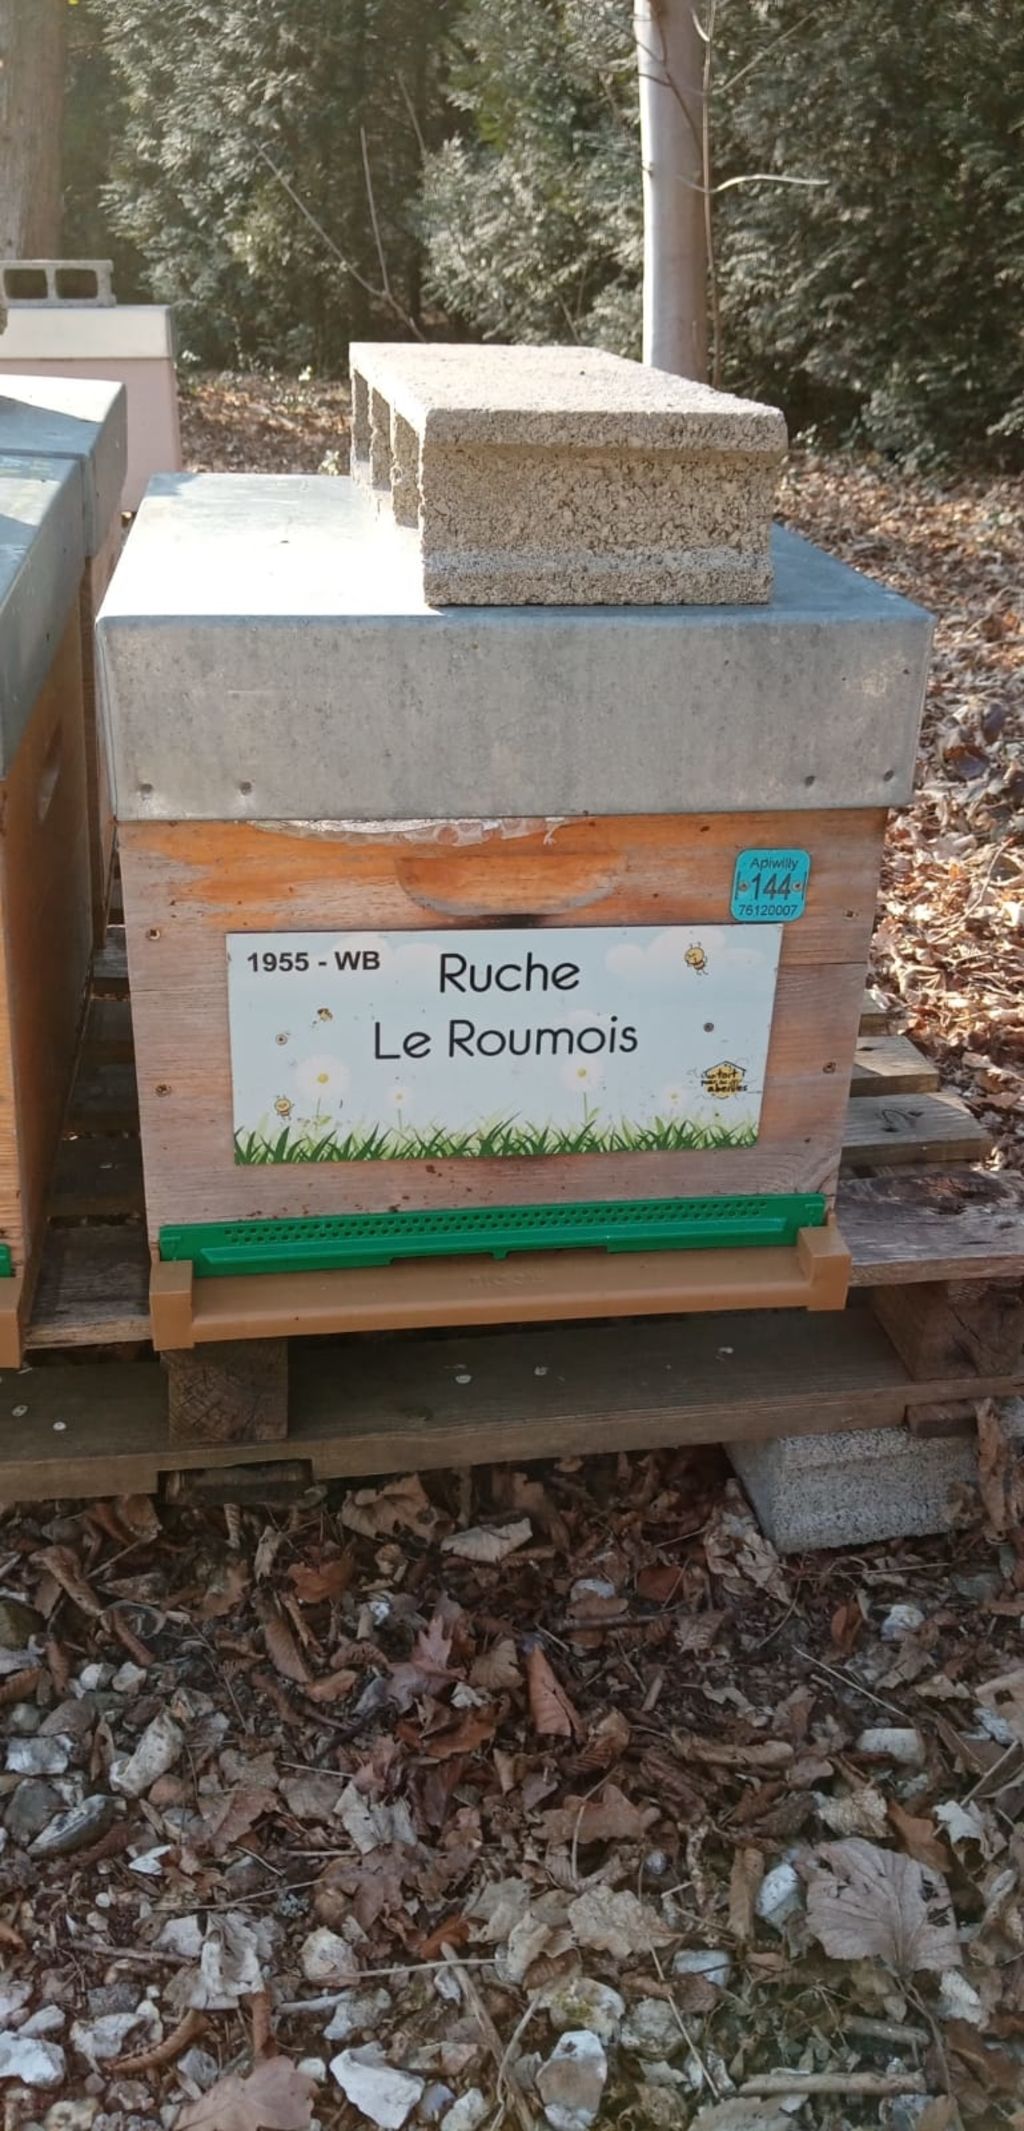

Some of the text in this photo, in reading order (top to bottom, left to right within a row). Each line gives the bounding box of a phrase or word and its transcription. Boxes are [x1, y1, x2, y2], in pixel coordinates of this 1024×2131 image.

[750, 857, 799, 872] Apiwilly
[751, 872, 792, 901] 144
[738, 903, 799, 917] 76120007
[247, 951, 310, 973] 1955
[334, 950, 381, 971] WB
[439, 951, 581, 993] Ruche
[374, 1015, 639, 1060] Le Roumois
